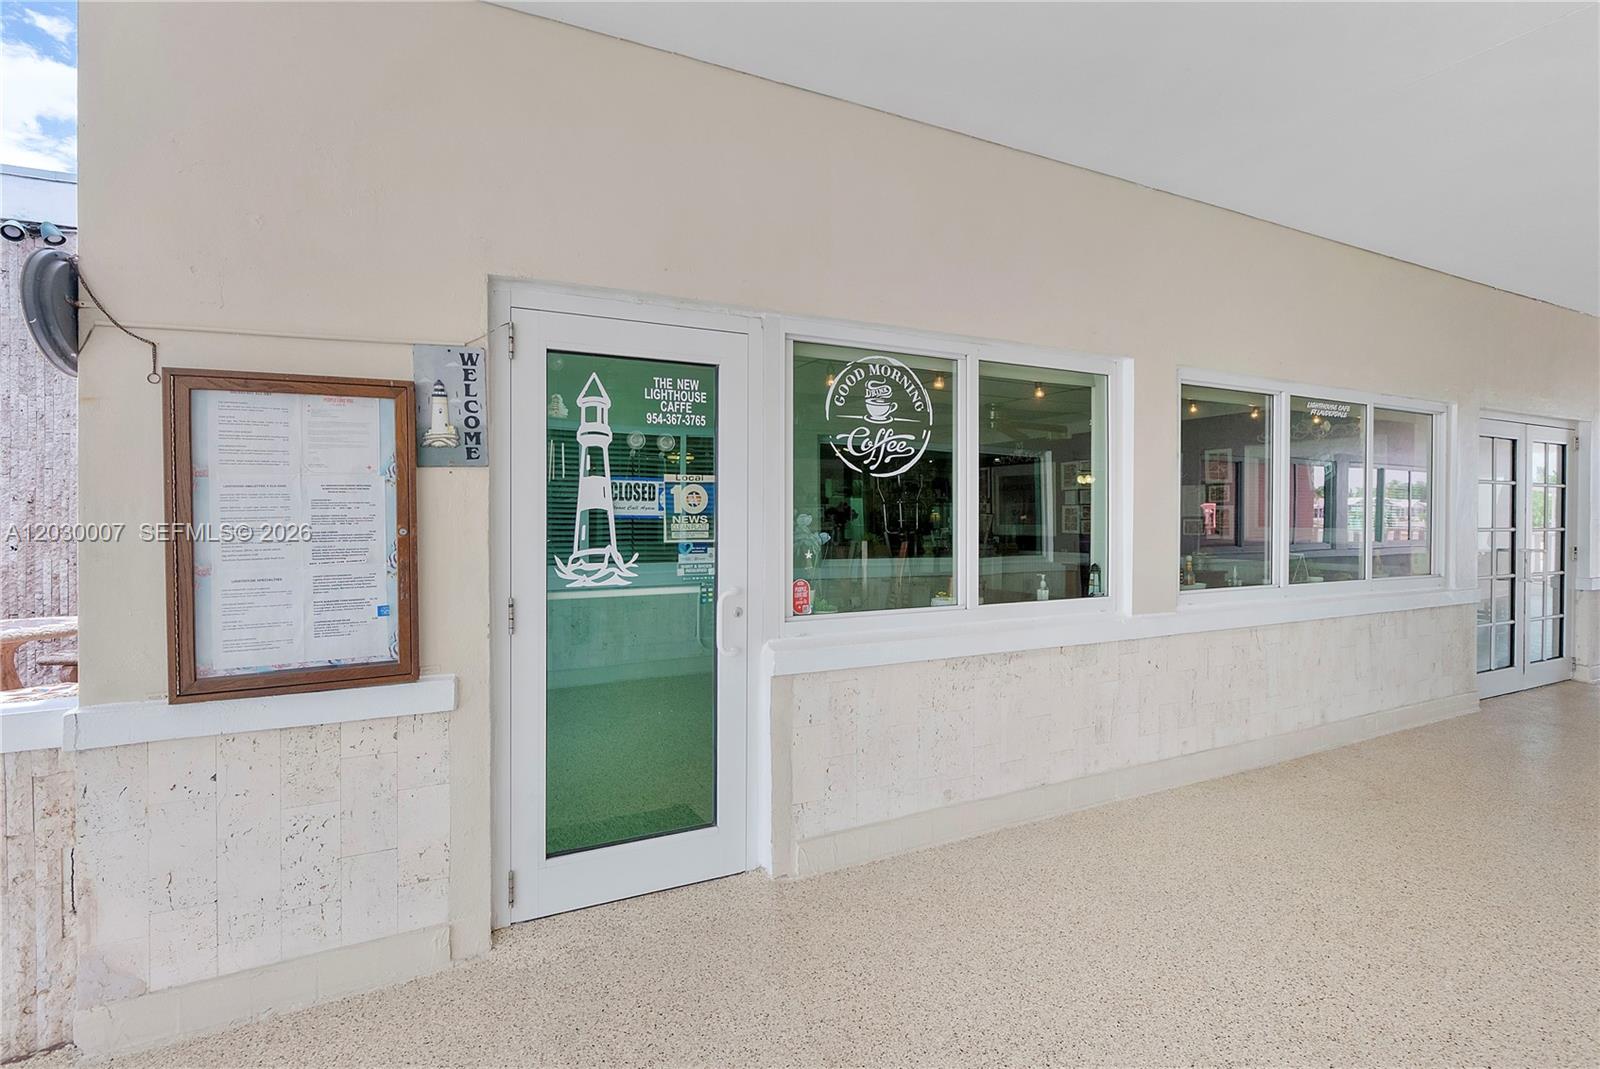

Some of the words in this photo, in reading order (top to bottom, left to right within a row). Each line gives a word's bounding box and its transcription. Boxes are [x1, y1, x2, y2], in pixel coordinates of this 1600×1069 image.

[653, 377, 673, 389] THE
[677, 378, 699, 391] NEW
[833, 368, 865, 407] GOOD
[868, 364, 925, 412] MORNING
[644, 387, 707, 404] LIGHTHOUSE
[864, 387, 889, 399] DRINK
[459, 352, 481, 460] WELCOME
[660, 400, 692, 414] CAFFE
[1306, 401, 1338, 411] LIGHTHOUSE
[1338, 404, 1351, 412] CAFE
[646, 412, 706, 426] 954-367-3765
[836, 426, 916, 471] Coffee
[675, 474, 704, 482] Local
[611, 481, 656, 502] CLOSED
[670, 484, 709, 514] 10
[672, 515, 709, 524] NEWS
